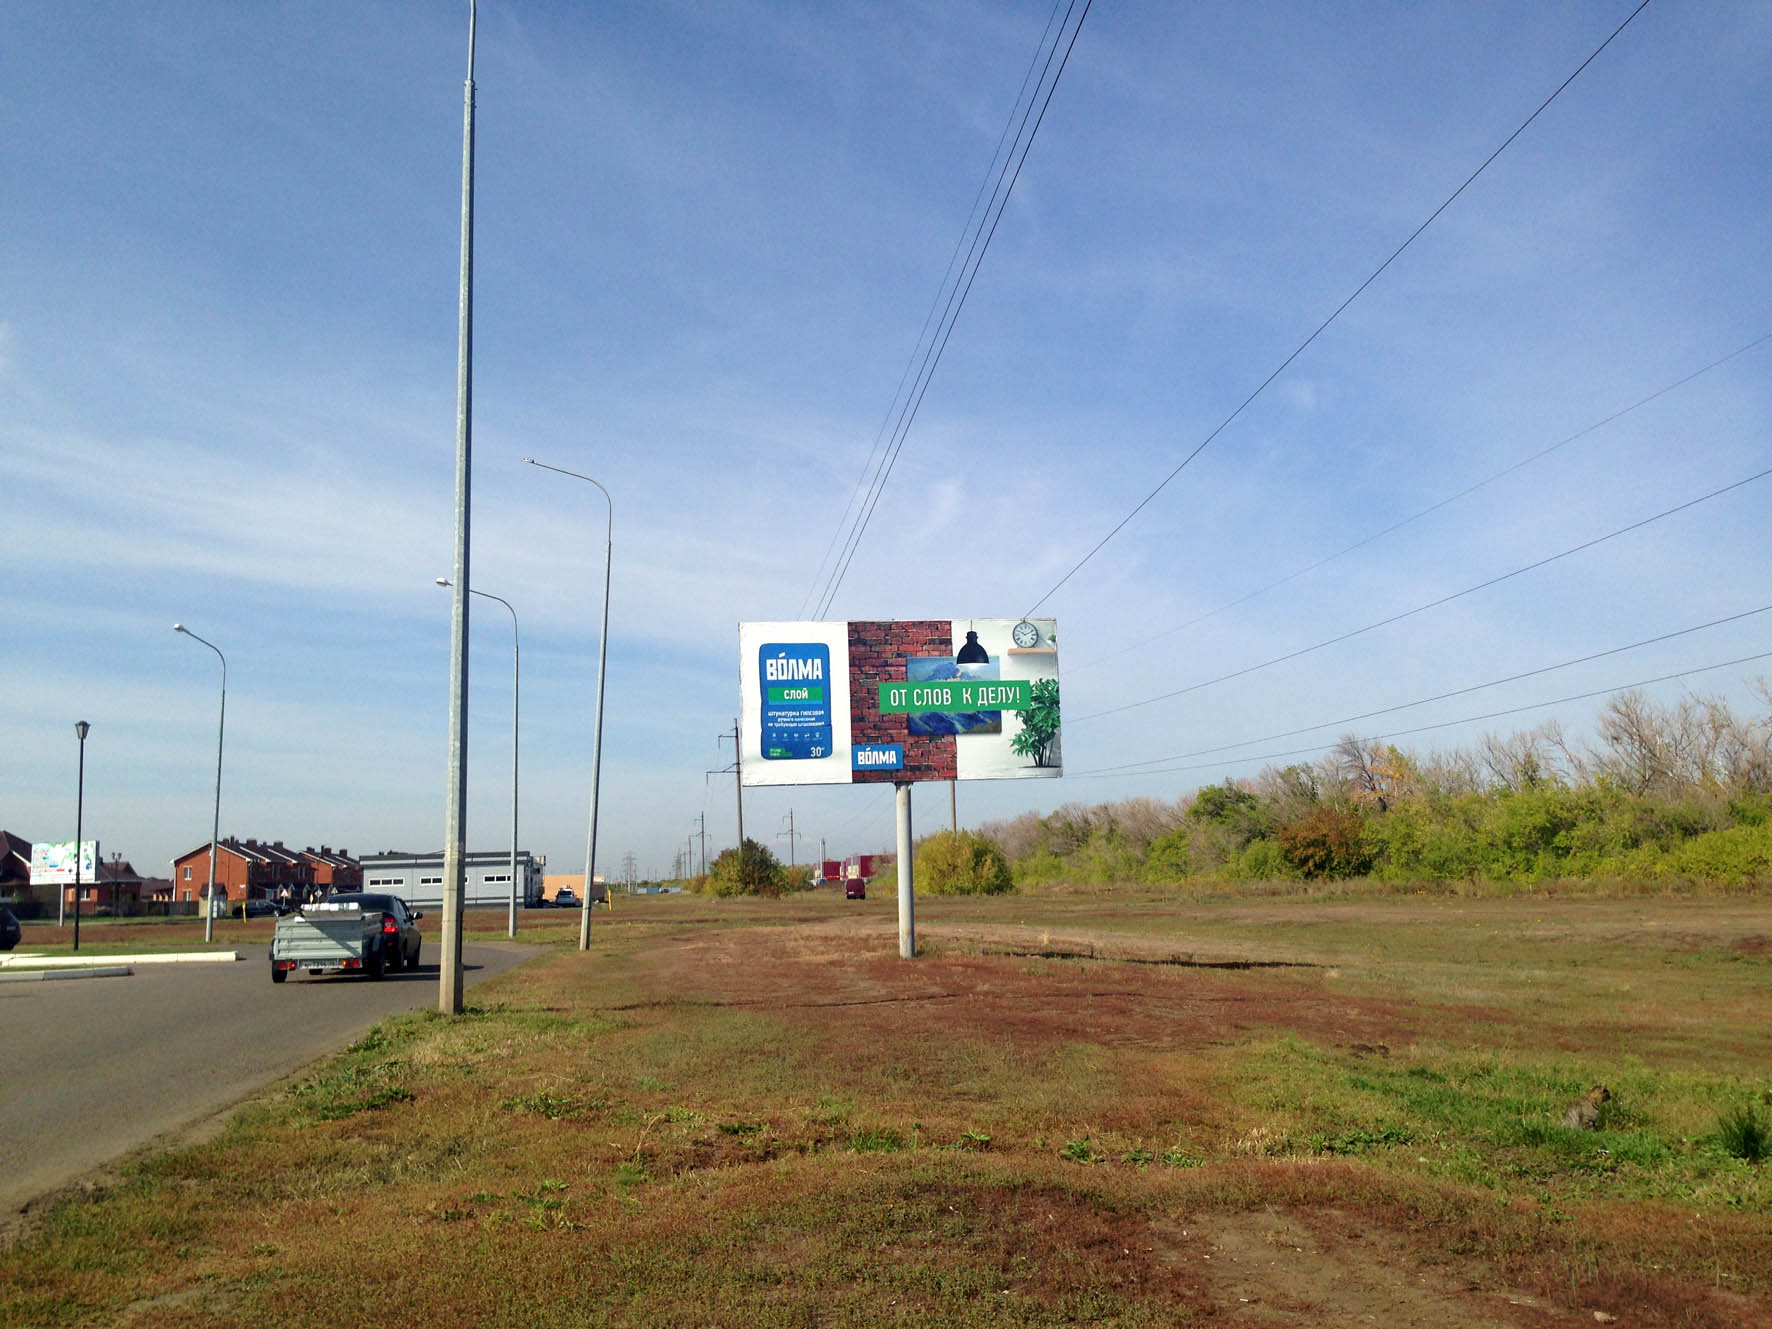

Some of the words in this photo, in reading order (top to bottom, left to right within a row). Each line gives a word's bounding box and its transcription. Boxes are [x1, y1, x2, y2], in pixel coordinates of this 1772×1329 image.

[890, 689, 907, 706] ОТ
[913, 689, 951, 705] СЛОВ
[962, 688, 972, 704] К
[977, 687, 1020, 706] ДЕЛУ!
